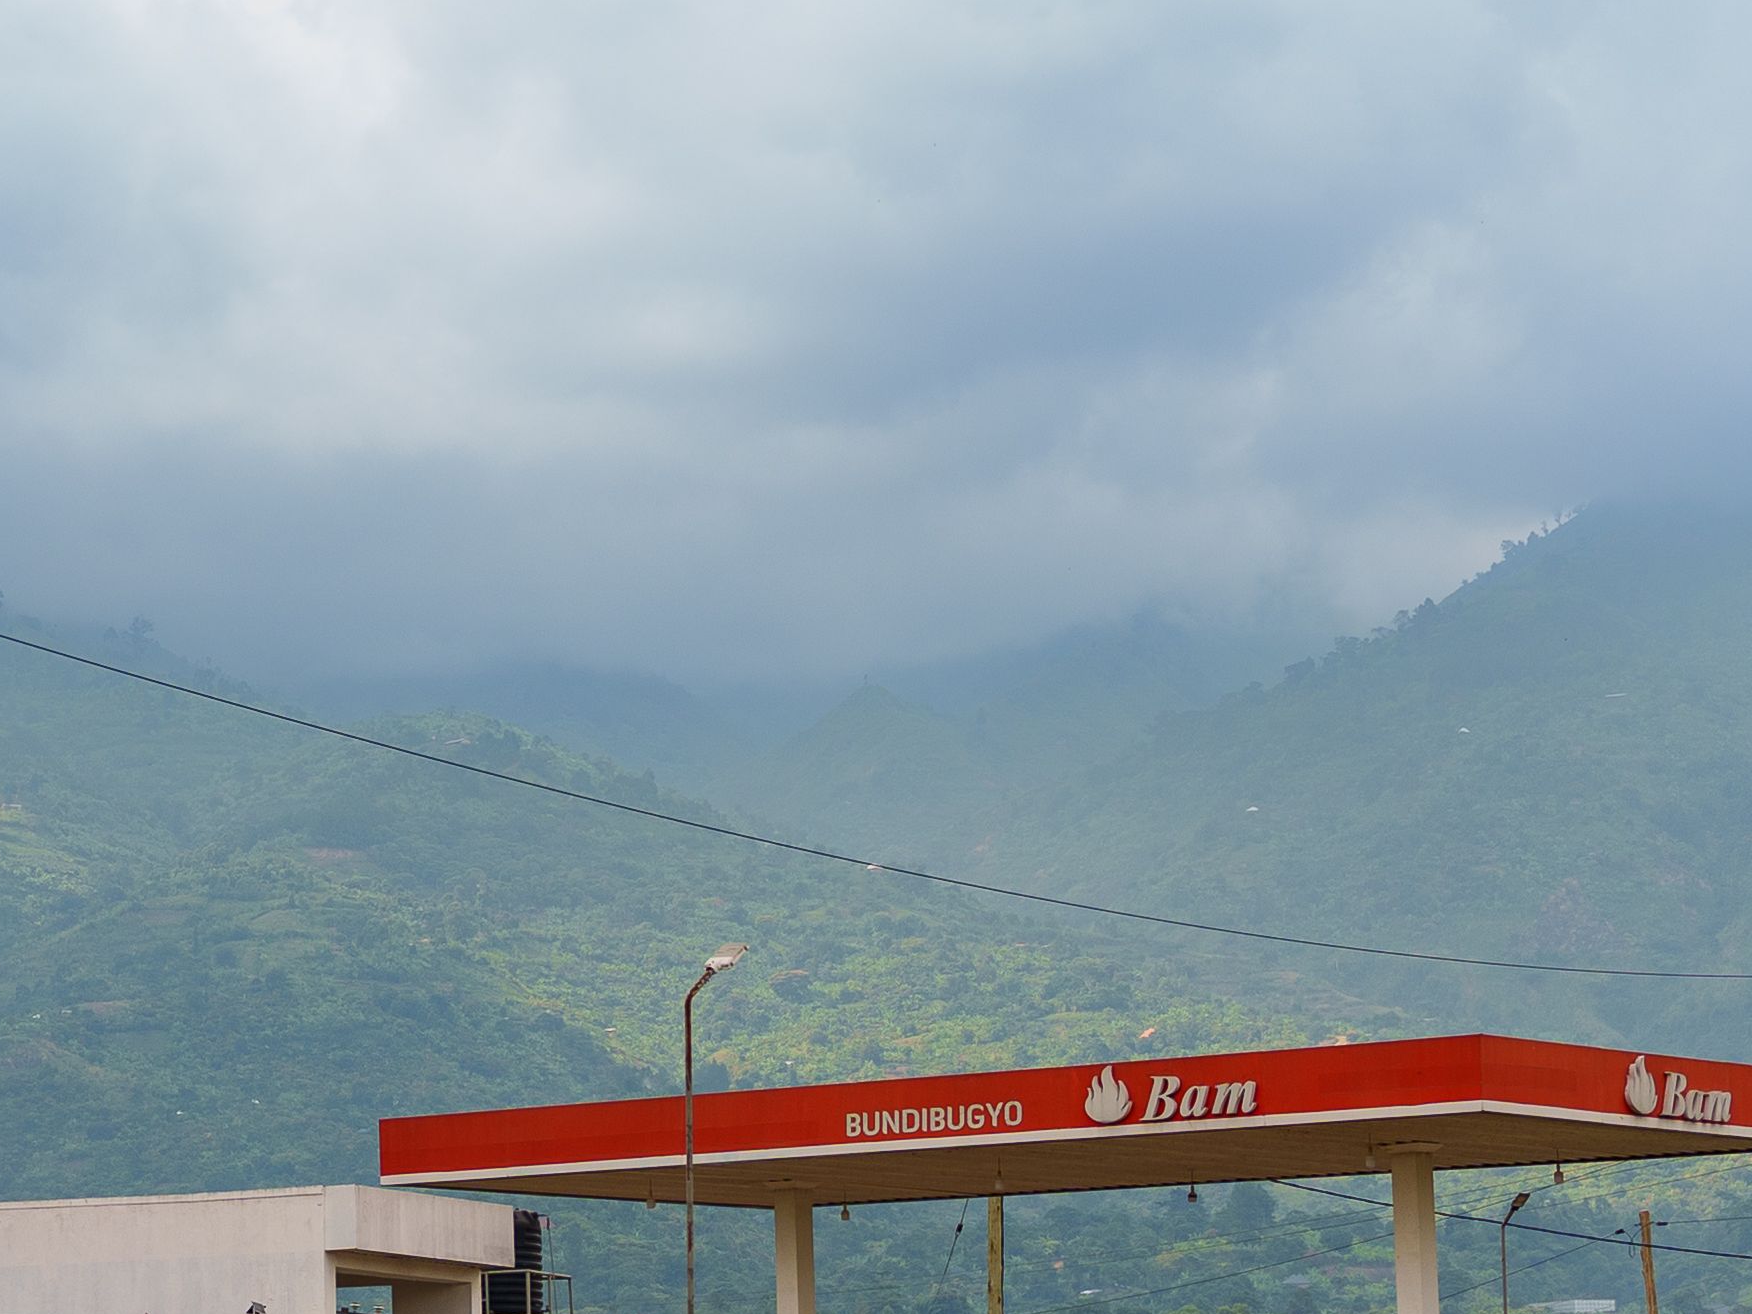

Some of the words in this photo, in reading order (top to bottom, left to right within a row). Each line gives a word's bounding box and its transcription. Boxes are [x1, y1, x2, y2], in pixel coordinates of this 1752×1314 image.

[845, 1100, 1024, 1138] BUNDIBUGYO
[1139, 1075, 1257, 1121] Bam
[1660, 1071, 1732, 1122] Bam
